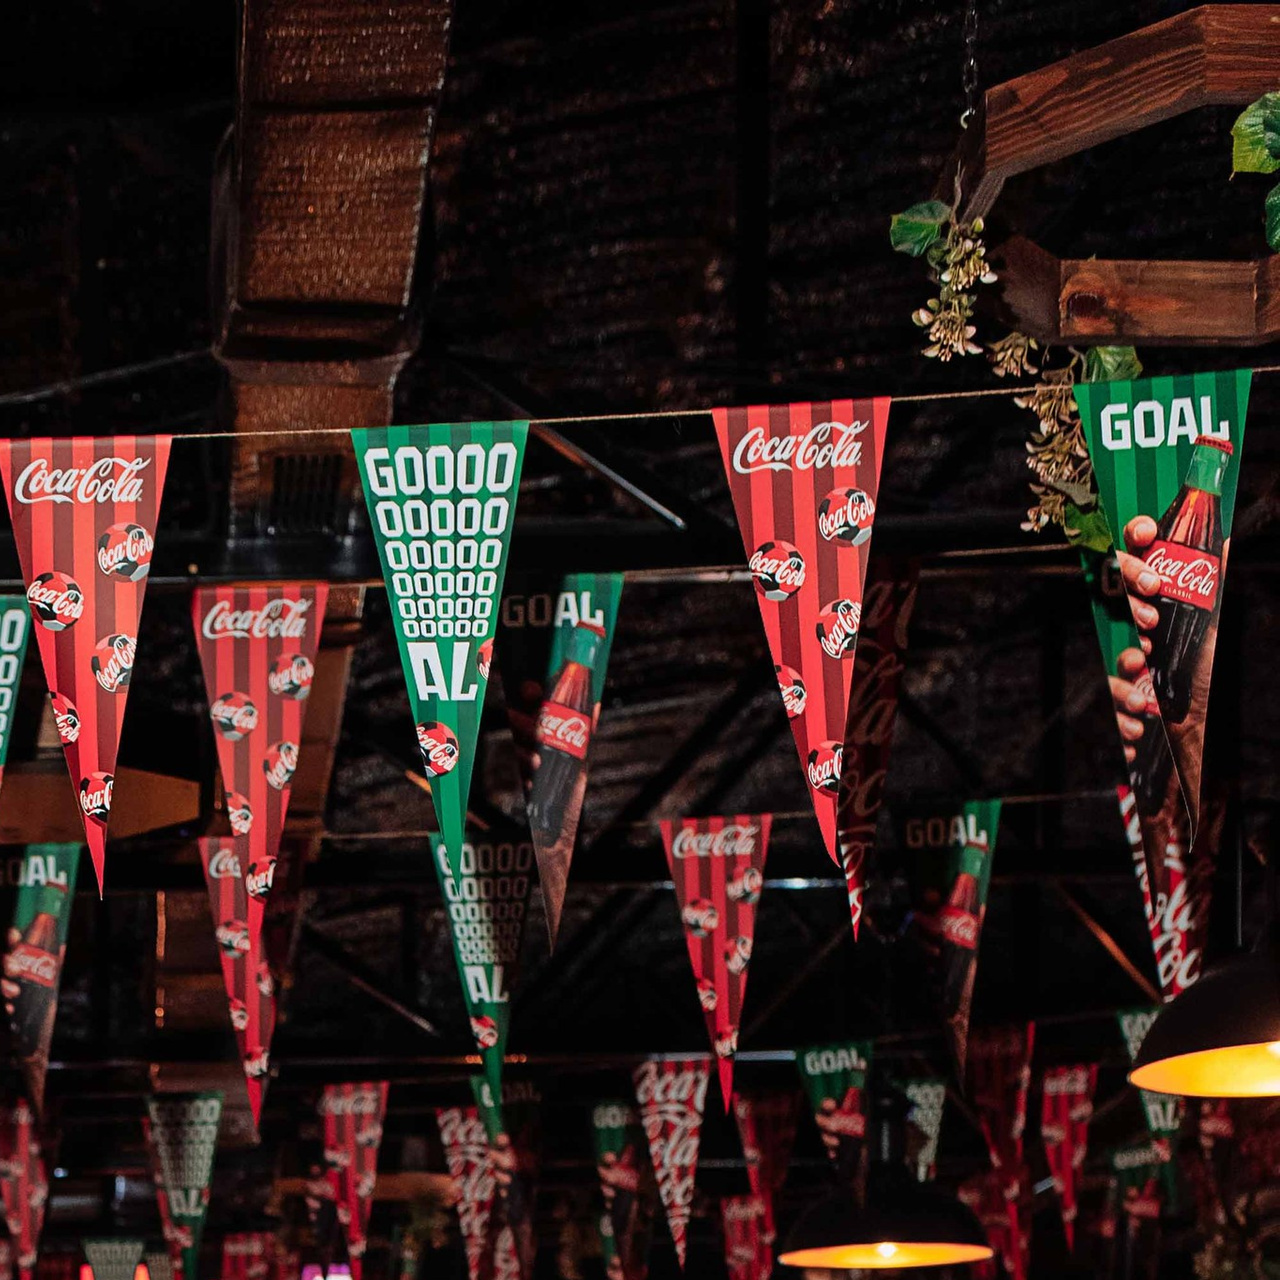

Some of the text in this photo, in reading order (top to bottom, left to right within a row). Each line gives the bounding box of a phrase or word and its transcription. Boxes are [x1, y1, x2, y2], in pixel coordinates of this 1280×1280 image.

[1100, 396, 1230, 450] GOAL
[733, 420, 869, 474] Coca-Cola
[15, 457, 151, 504] Coca-Cola
[364, 442, 517, 496] GOOOO
[375, 497, 509, 537] OOOOO
[385, 538, 502, 570] OOOOO
[1145, 547, 1219, 597] Coca-Cola
[392, 571, 497, 597] OOOOO
[1164, 587, 1193, 600] CLASSIC
[203, 599, 313, 639] Coca-Cola
[398, 597, 492, 619] OOOOO
[402, 619, 489, 637] OOOOO
[502, 591, 604, 627] GOAL
[406, 642, 478, 701] AL
[464, 966, 509, 1003] AL
